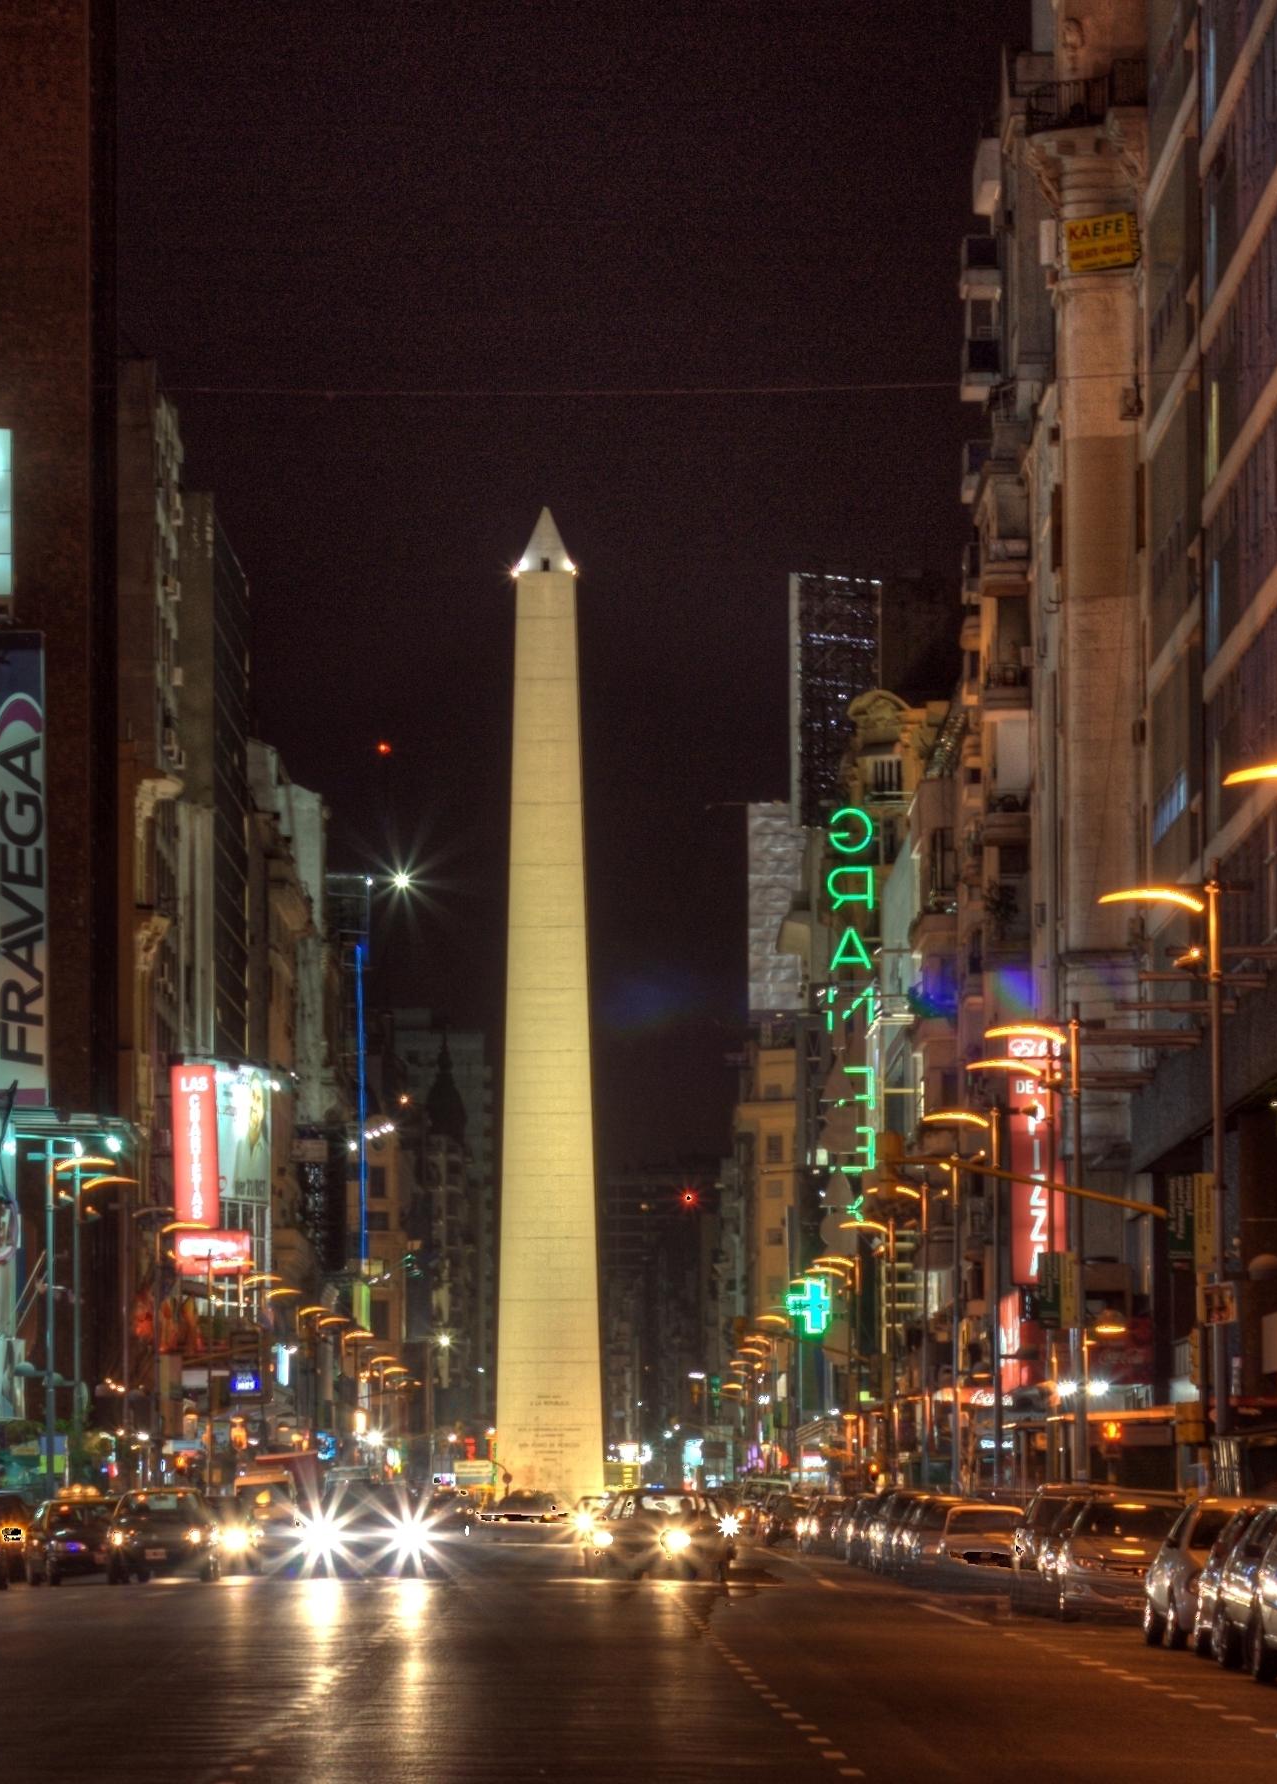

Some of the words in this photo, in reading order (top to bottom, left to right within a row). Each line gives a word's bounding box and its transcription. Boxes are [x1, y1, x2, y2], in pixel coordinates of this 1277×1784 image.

[1069, 219, 1124, 241] KAEFE
[180, 1076, 209, 1092] LAS
[1016, 1080, 1035, 1094] DE
